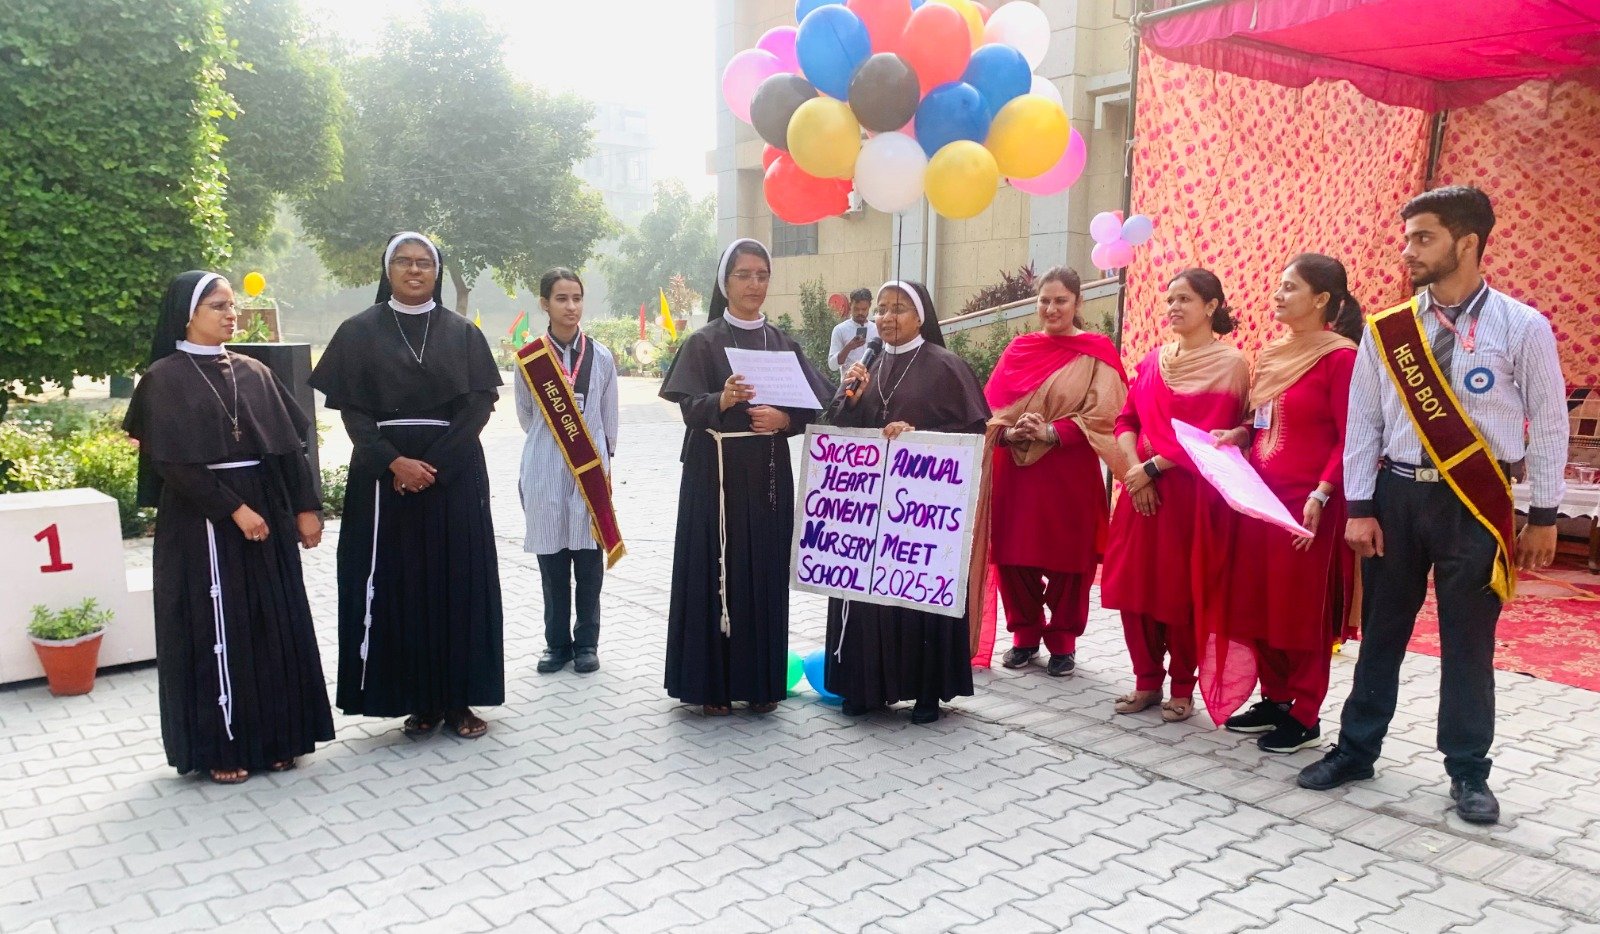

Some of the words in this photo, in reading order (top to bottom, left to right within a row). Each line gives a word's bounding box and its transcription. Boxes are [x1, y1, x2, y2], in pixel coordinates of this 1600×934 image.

[1393, 342, 1425, 388] HEAD
[1414, 385, 1447, 421] BOY
[542, 379, 567, 413] HEAD
[560, 413, 580, 443] GIRL
[810, 434, 880, 467] SACRED
[890, 448, 963, 485] ANNUAL
[820, 464, 881, 495] HEART
[805, 489, 879, 527] CONVENT
[887, 487, 962, 532] SPORTS
[34, 523, 73, 573] 1
[800, 520, 876, 563] NURSERY
[880, 533, 938, 566] MEET
[798, 554, 865, 592] SCHOOL
[872, 566, 955, 607] 2025-26
